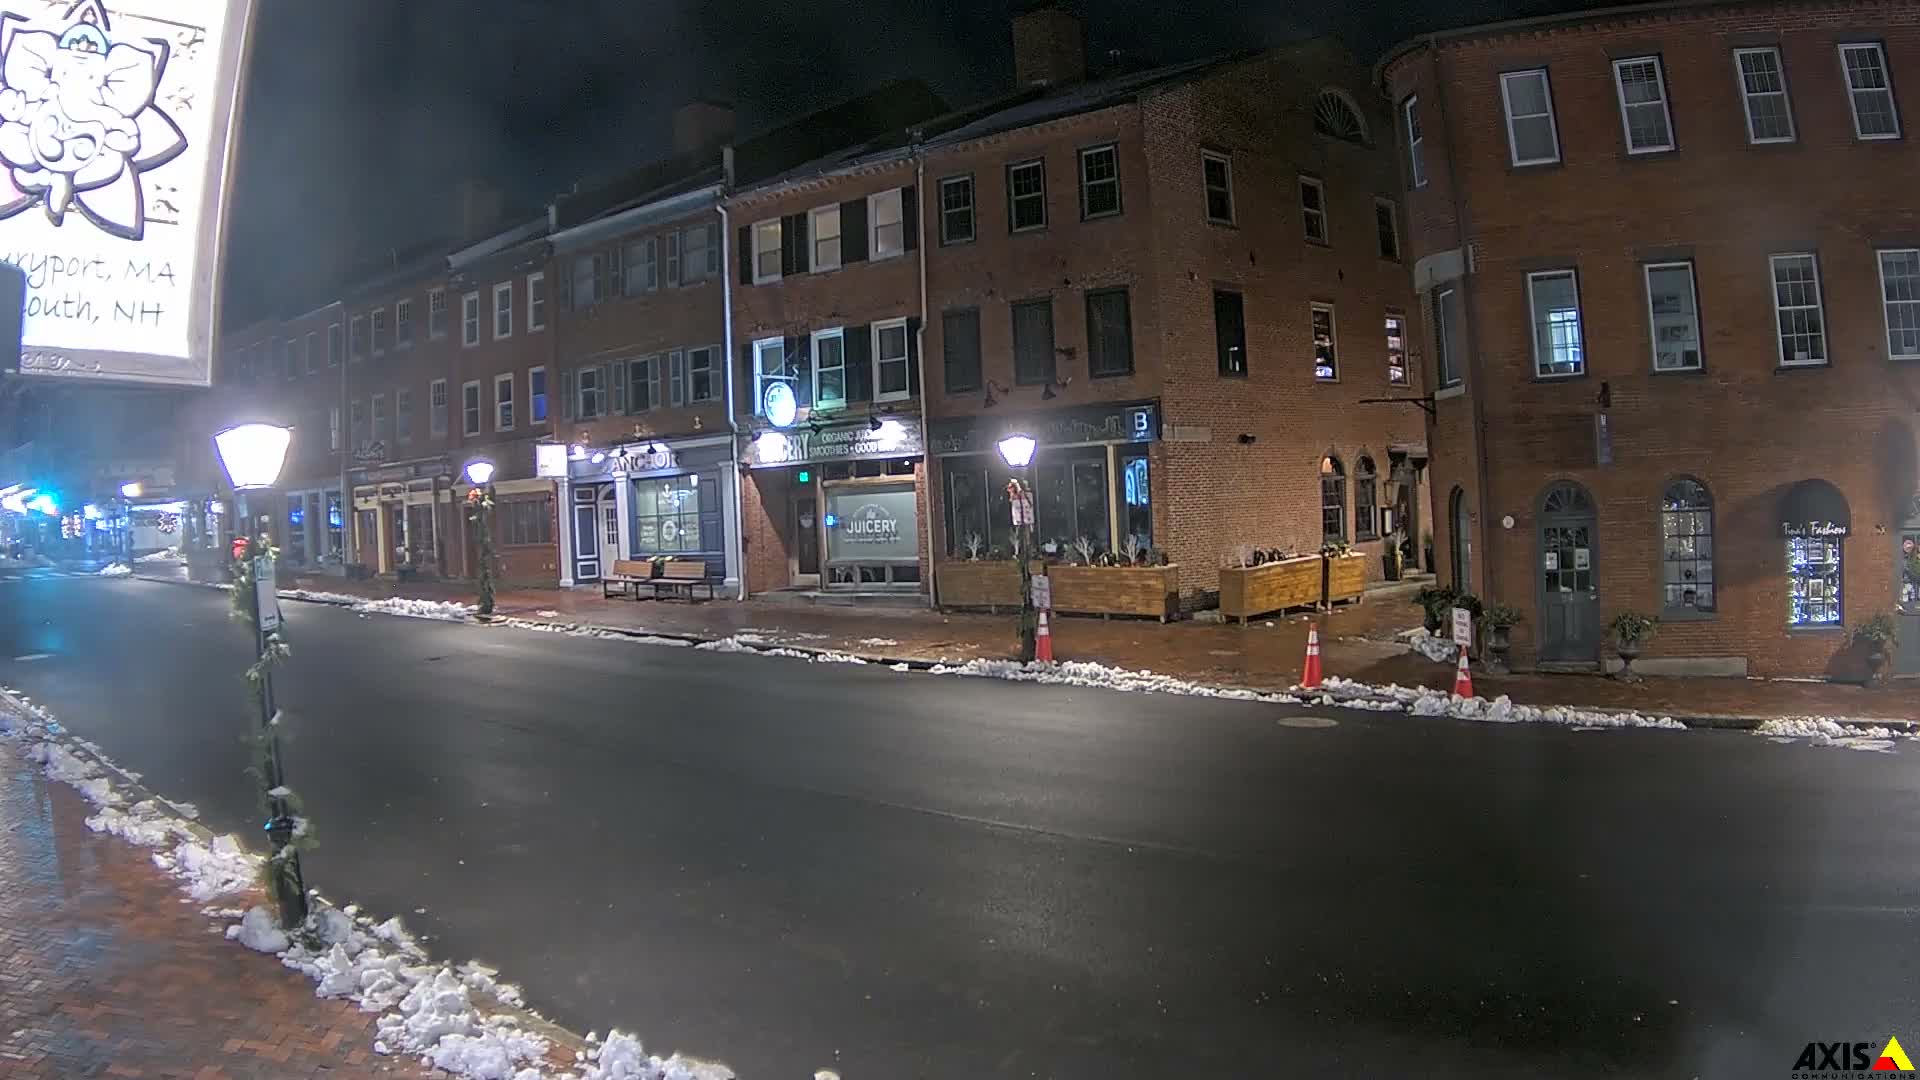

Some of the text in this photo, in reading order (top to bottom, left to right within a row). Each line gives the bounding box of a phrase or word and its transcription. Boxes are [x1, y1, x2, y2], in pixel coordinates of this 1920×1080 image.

[124, 259, 176, 287] MA
[24, 290, 165, 327] outh, NH
[1134, 411, 1147, 430] B
[821, 430, 853, 443] ORGANIC
[809, 444, 849, 457] SMOOTHIES
[611, 452, 680, 472] ANCOR
[846, 518, 897, 533] JUICERY
